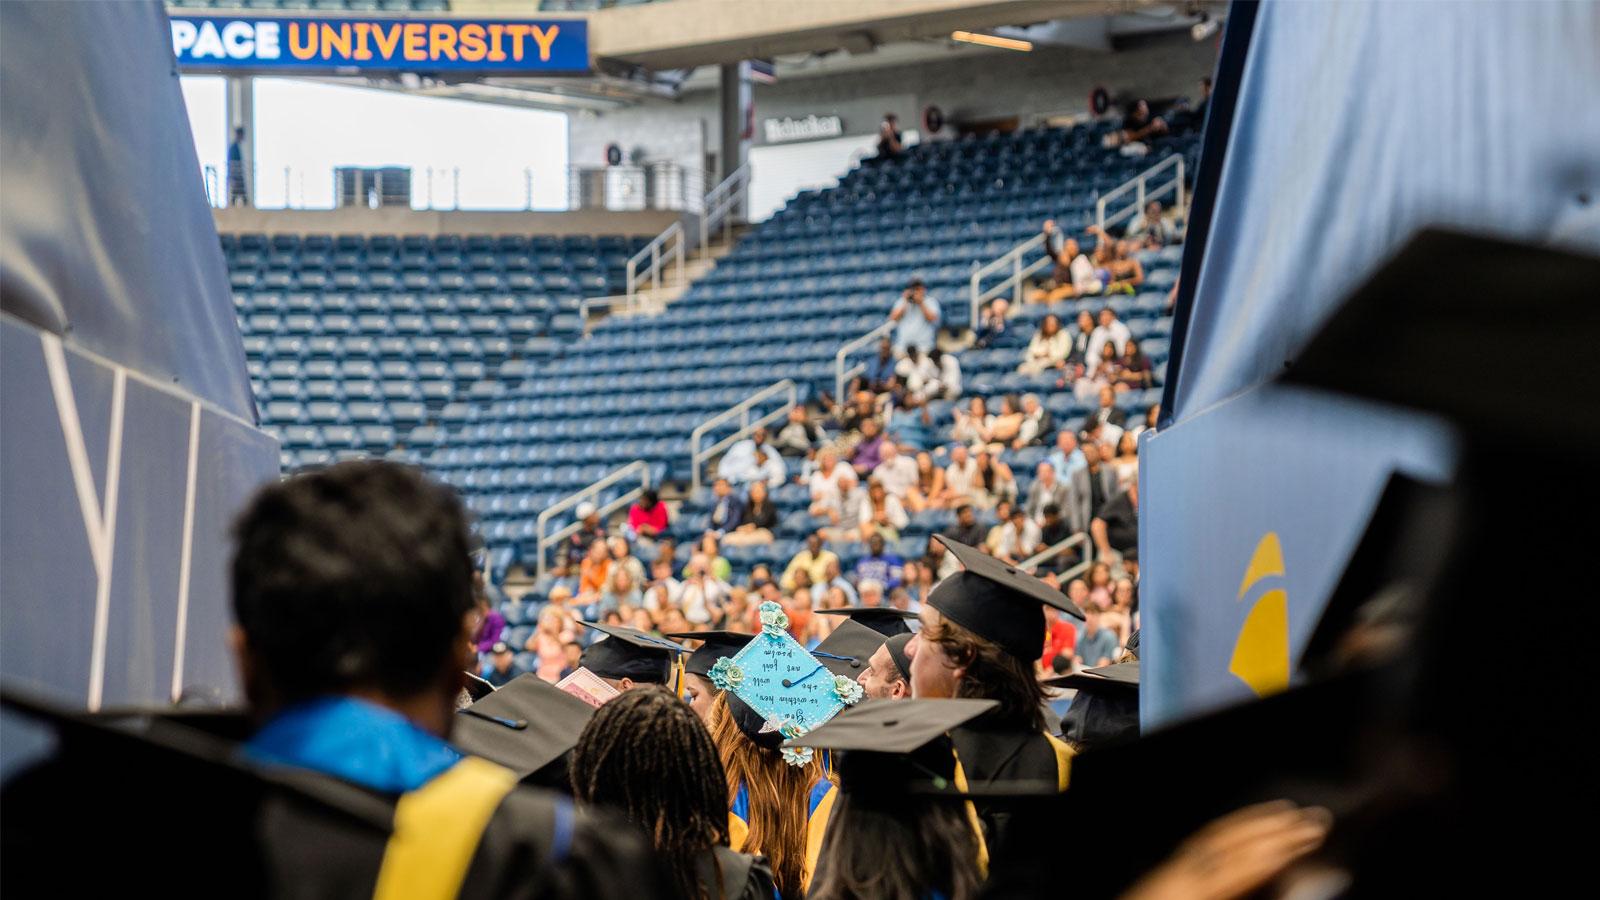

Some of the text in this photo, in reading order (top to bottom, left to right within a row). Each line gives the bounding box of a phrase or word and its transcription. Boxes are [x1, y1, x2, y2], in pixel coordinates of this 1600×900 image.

[170, 20, 560, 62] PACE UNIVERSITY
[762, 658, 801, 672] not fail
[752, 677, 818, 693] she will
[779, 696, 807, 706] within
